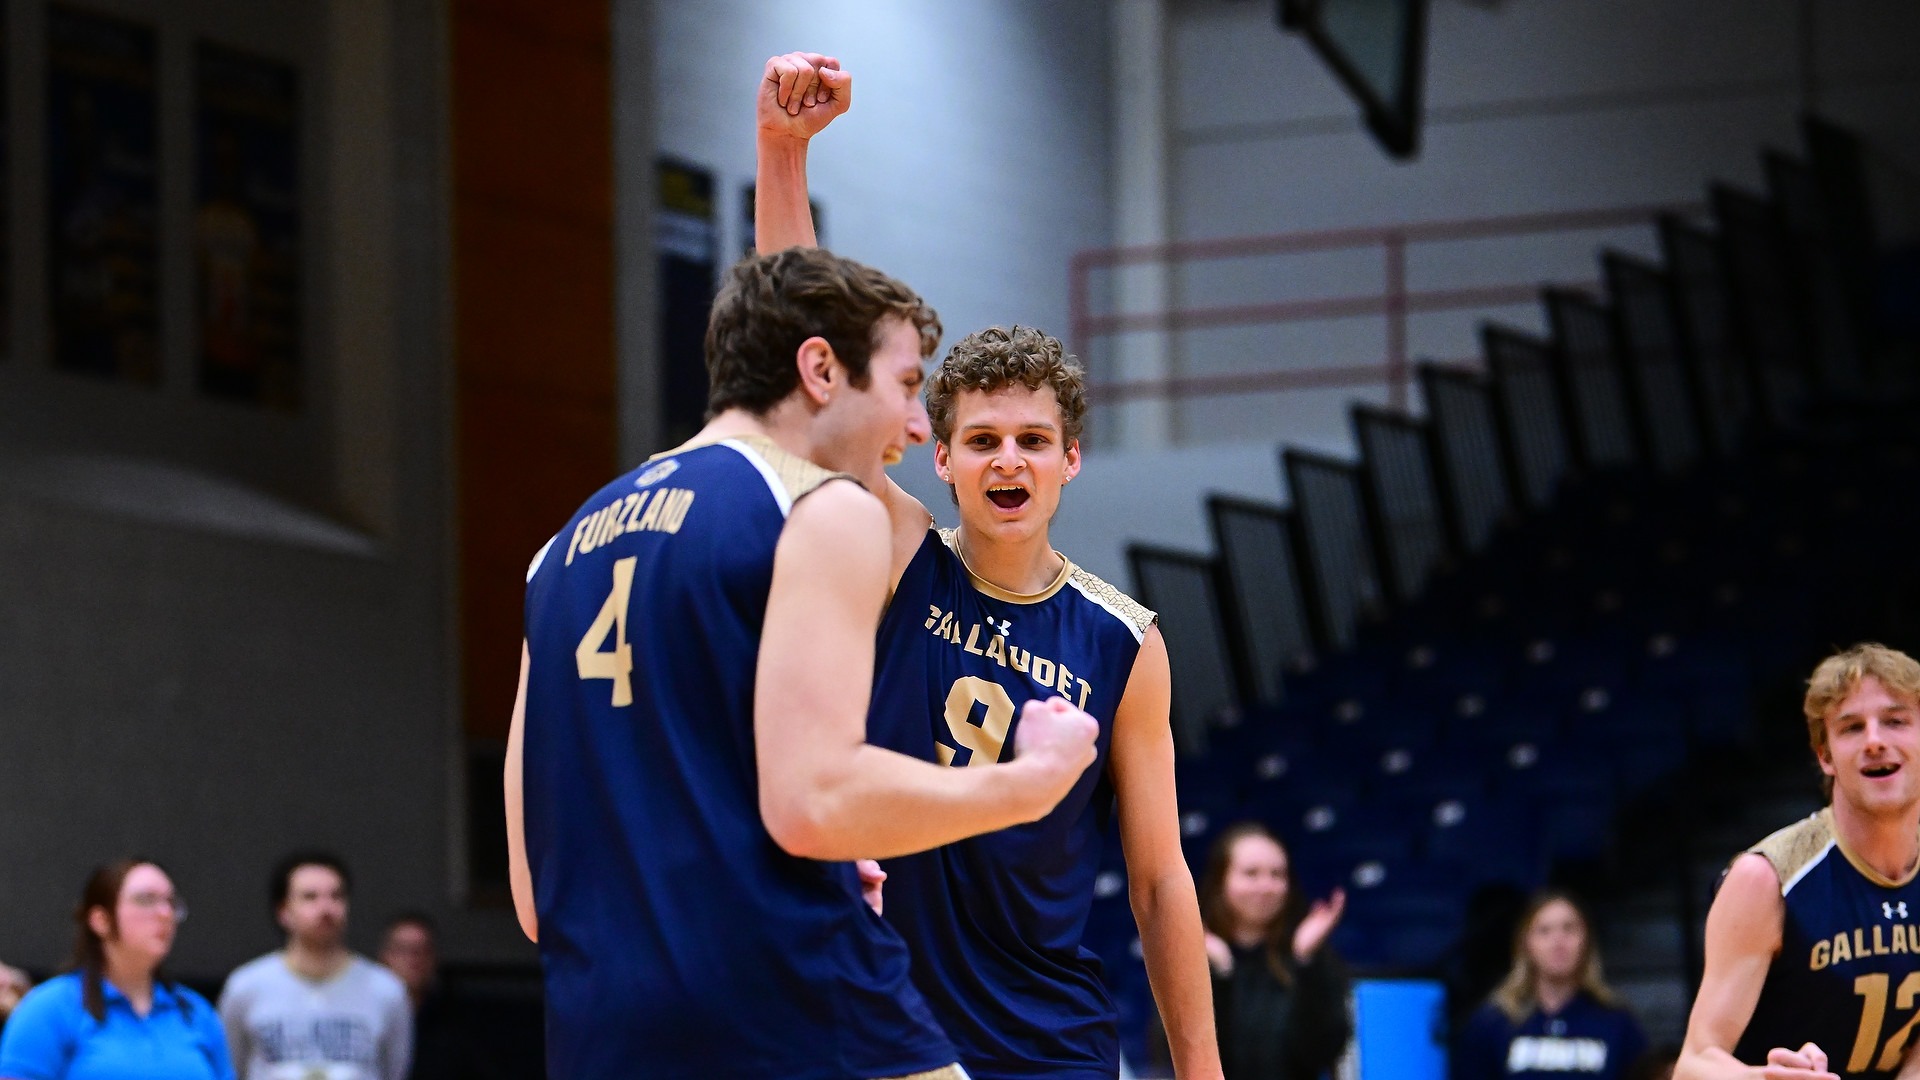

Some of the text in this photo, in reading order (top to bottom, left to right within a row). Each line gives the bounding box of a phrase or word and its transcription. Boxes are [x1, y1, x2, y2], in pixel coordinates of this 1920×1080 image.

[565, 488, 695, 567] FURZLAND
[575, 556, 637, 707] 4
[934, 676, 1016, 767] 9
[1846, 971, 1920, 1073] 12
